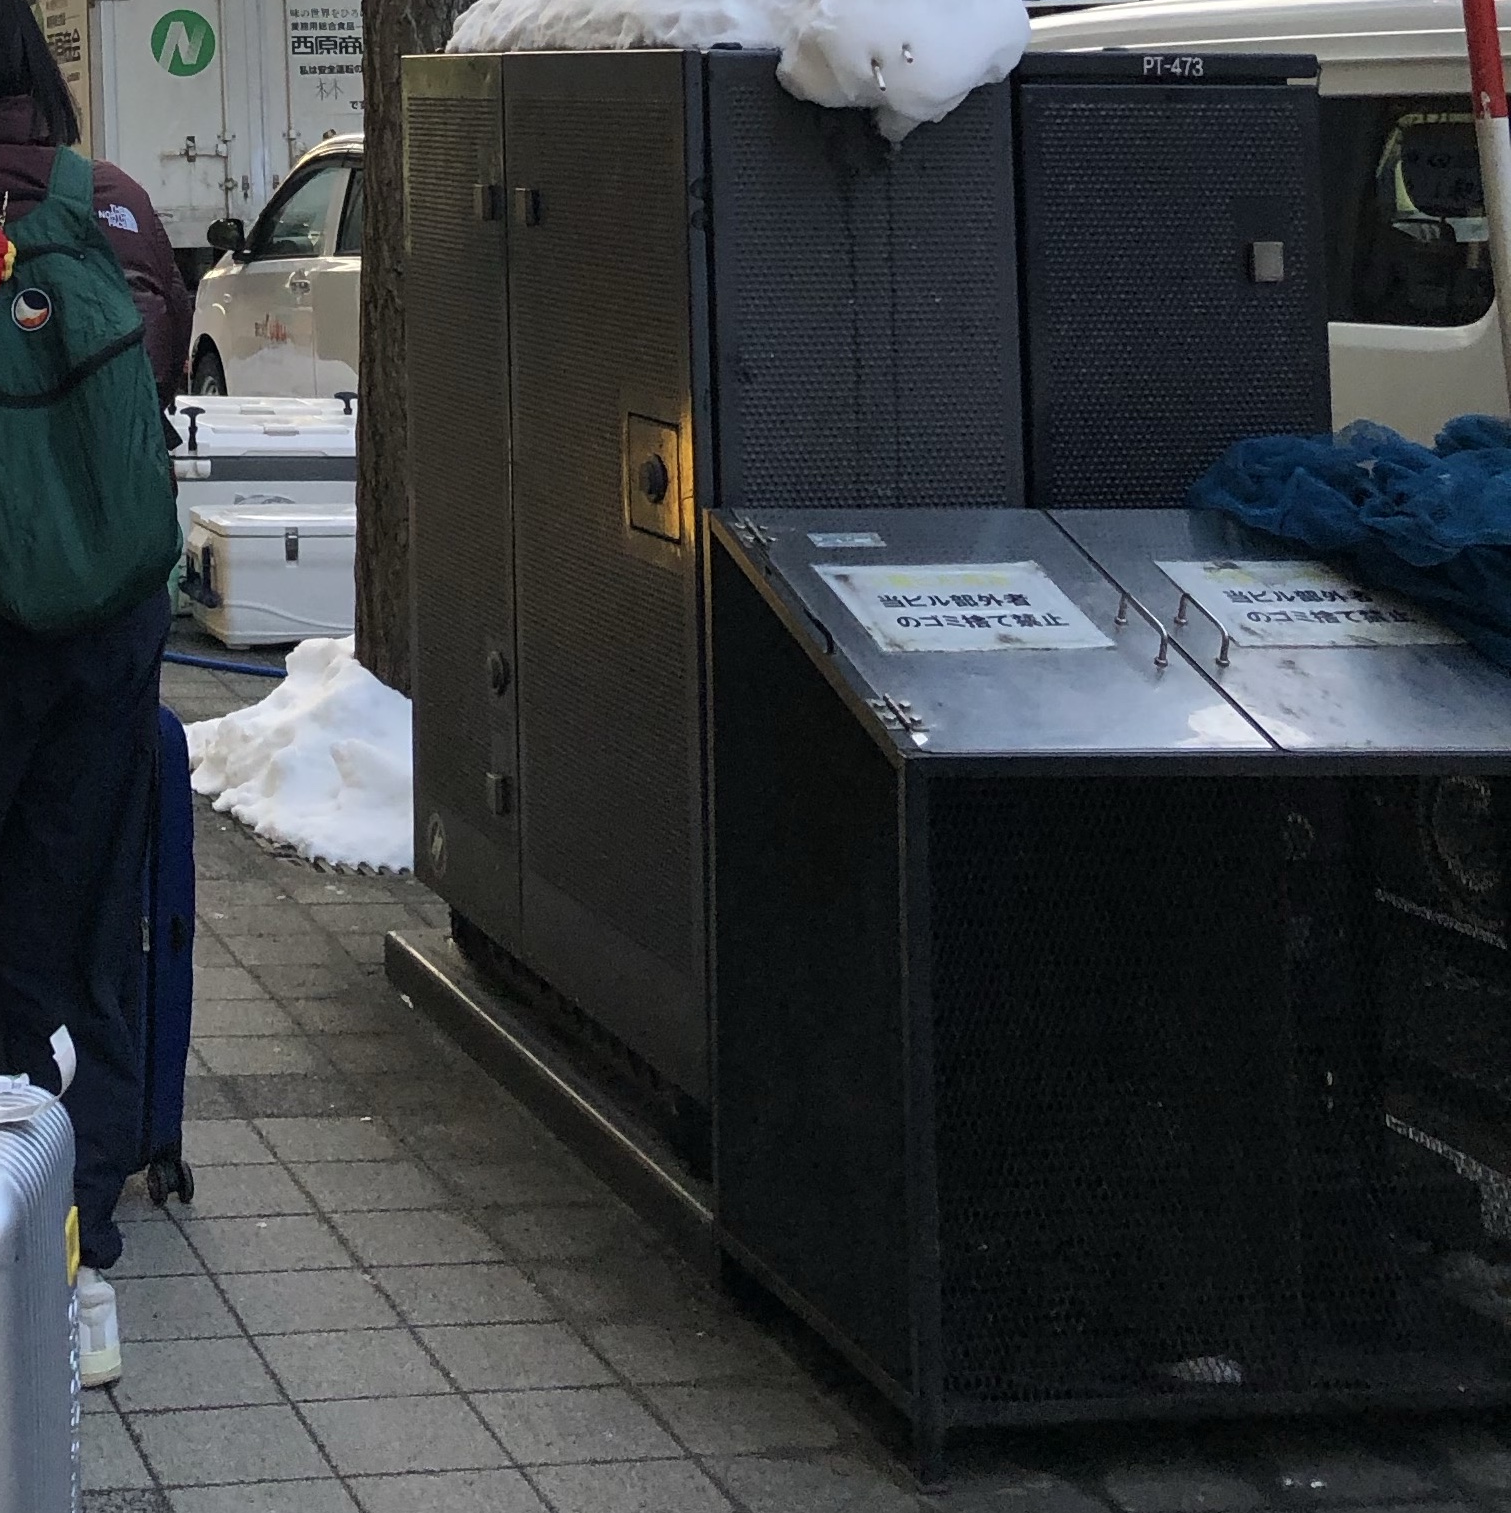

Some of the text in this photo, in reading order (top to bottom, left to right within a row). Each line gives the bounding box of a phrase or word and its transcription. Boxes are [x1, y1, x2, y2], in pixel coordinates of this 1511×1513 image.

[291, 35, 364, 55] 西原商
[1143, 56, 1204, 77] PT-473
[878, 593, 1032, 608] 当ビル部外者
[897, 612, 1071, 629] のゴミ捨て禁止
